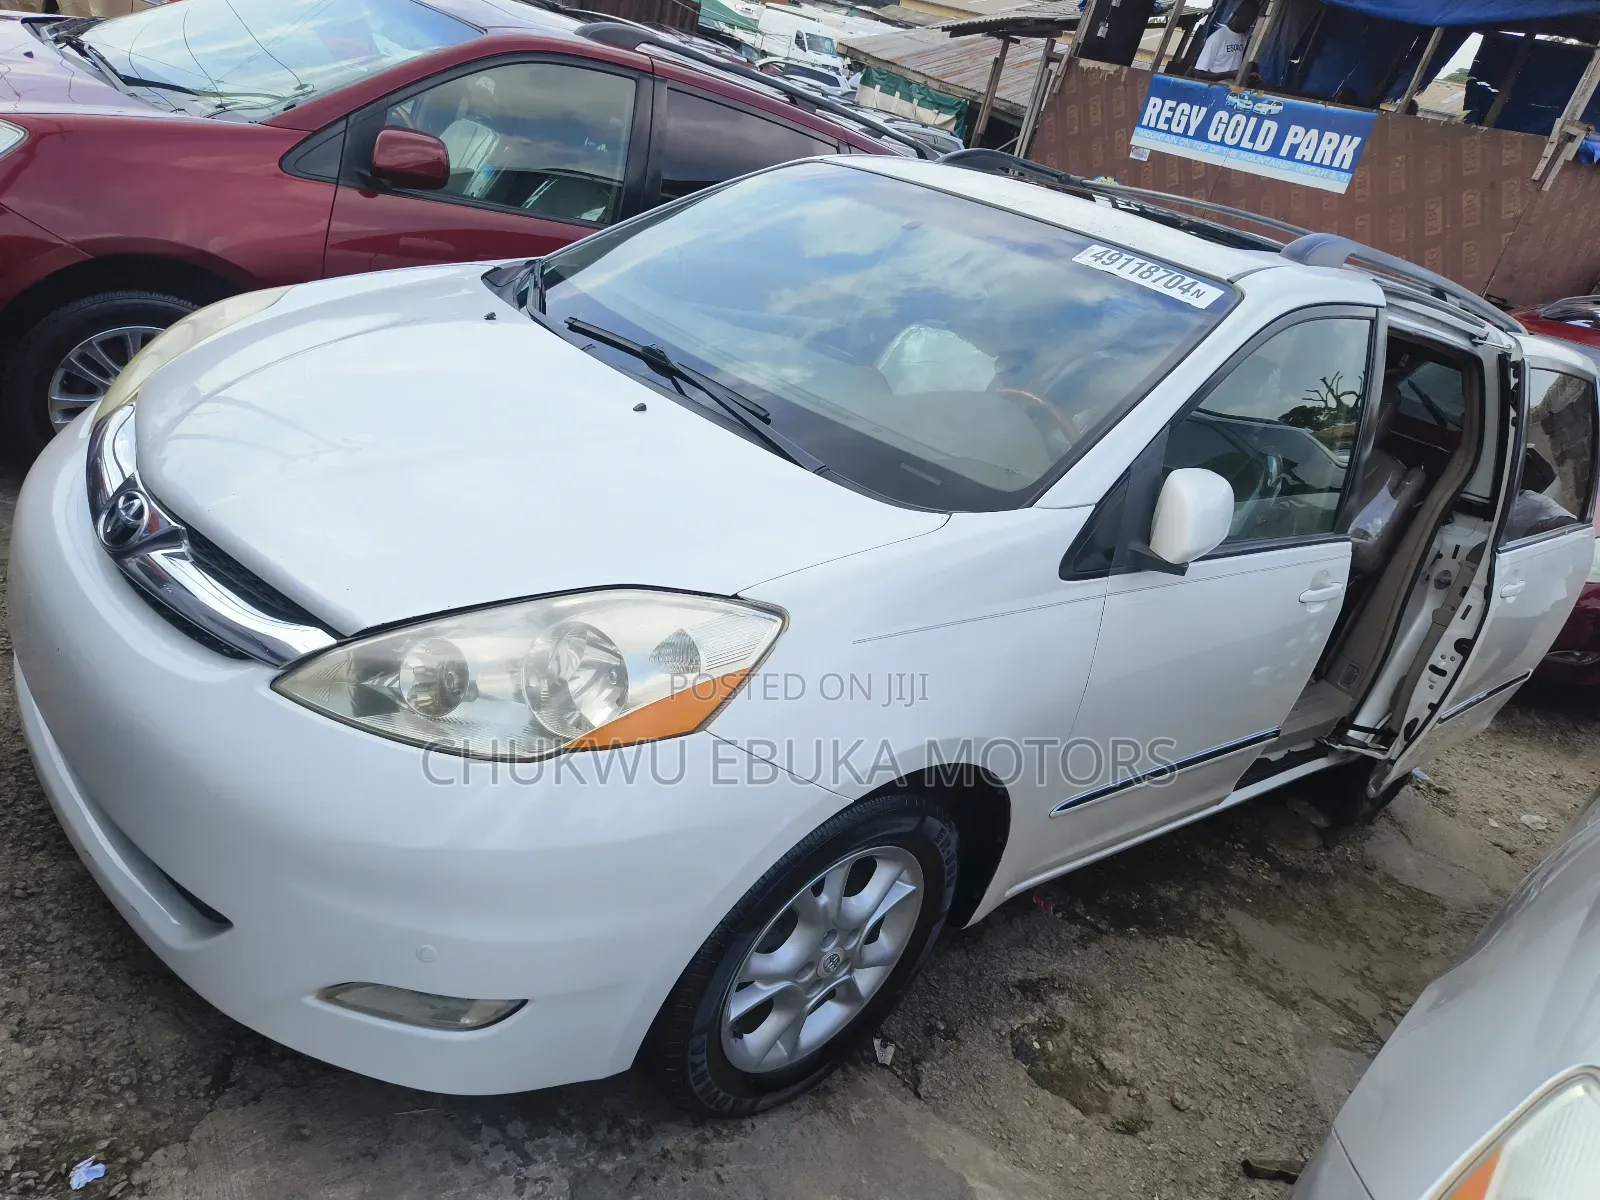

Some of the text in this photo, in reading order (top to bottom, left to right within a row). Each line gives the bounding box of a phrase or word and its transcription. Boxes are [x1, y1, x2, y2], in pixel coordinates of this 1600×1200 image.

[1141, 97, 1207, 137] REGY
[1207, 110, 1278, 152] GOLD
[1279, 124, 1361, 170] PARK
[1178, 139, 1191, 148] ON
[1193, 141, 1208, 151] TOP
[1209, 145, 1221, 154] OF
[1223, 148, 1238, 158] THE
[1090, 250, 1198, 294] 49118704
